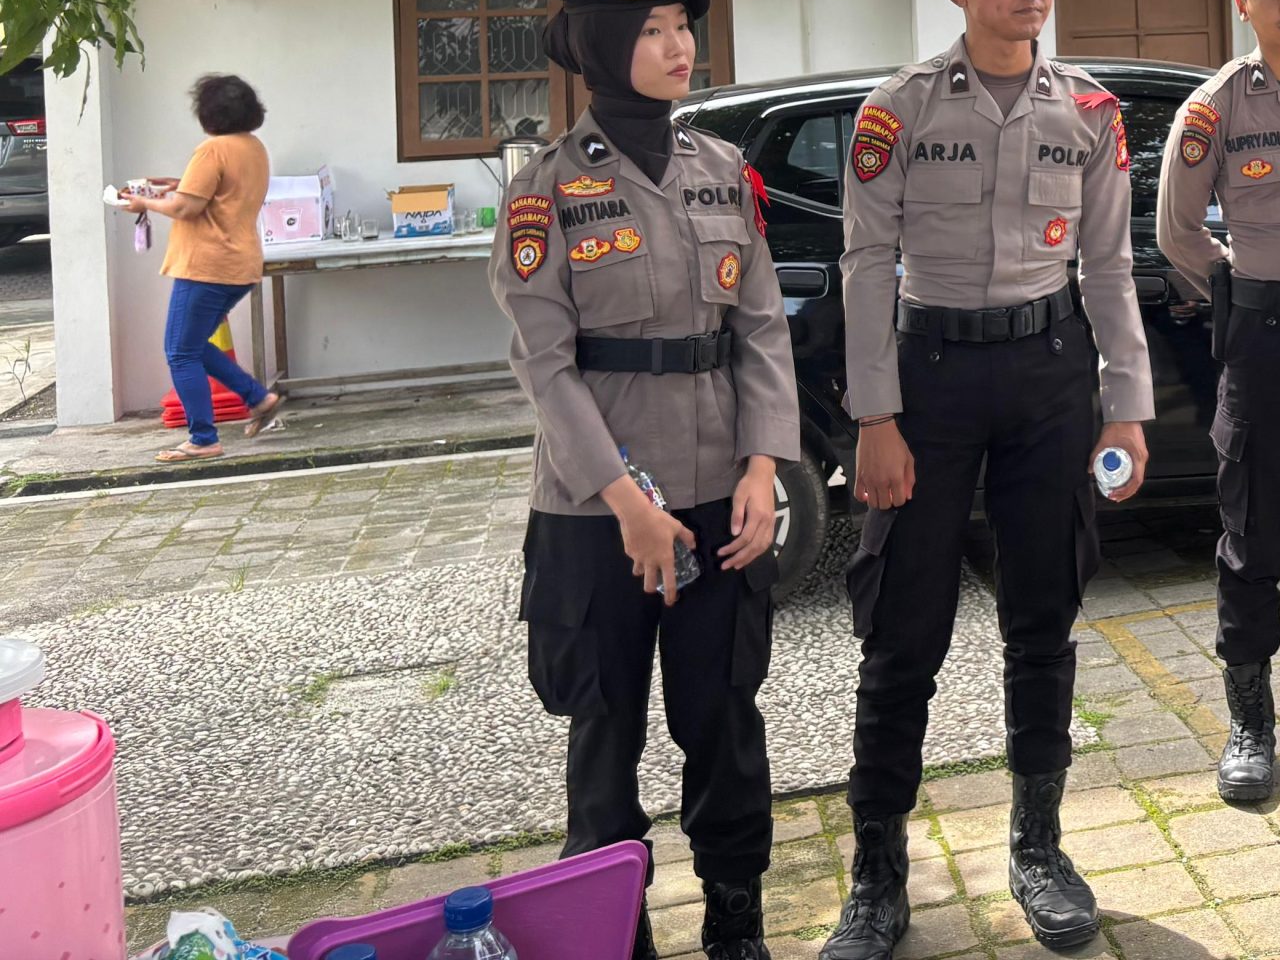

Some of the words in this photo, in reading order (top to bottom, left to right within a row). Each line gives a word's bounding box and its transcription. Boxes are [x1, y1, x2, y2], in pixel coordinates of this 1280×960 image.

[914, 141, 977, 162] ARJA
[1038, 143, 1090, 167] POLRI
[561, 198, 632, 230] MUTIARA
